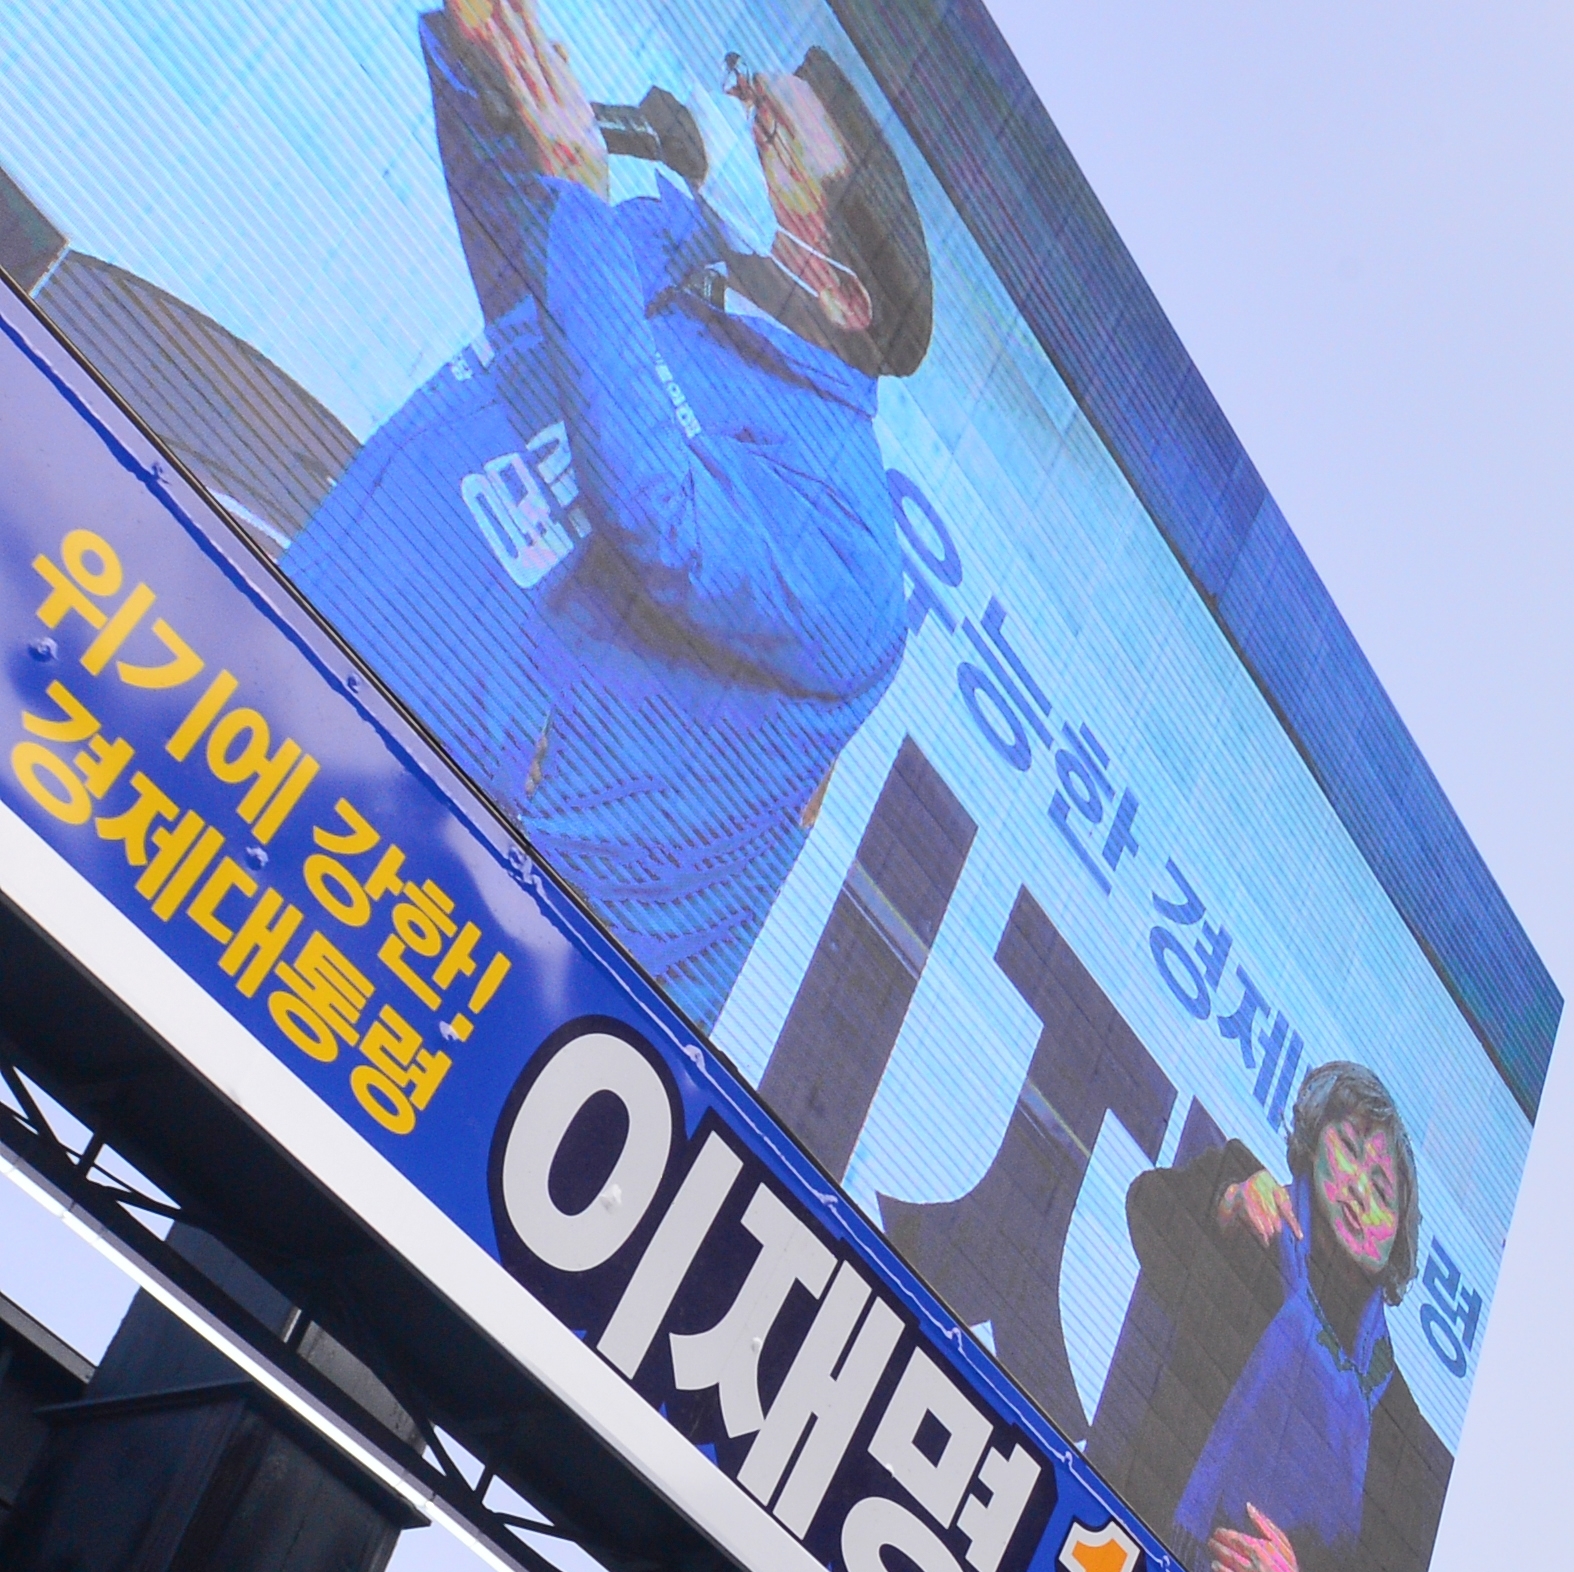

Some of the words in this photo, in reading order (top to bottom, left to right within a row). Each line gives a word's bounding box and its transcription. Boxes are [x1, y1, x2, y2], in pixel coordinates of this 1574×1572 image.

[11, 681, 452, 1134] 경제대통령
[31, 528, 320, 844] 위기에
[304, 798, 512, 1041] 강한!
[884, 468, 1140, 897] 유능한
